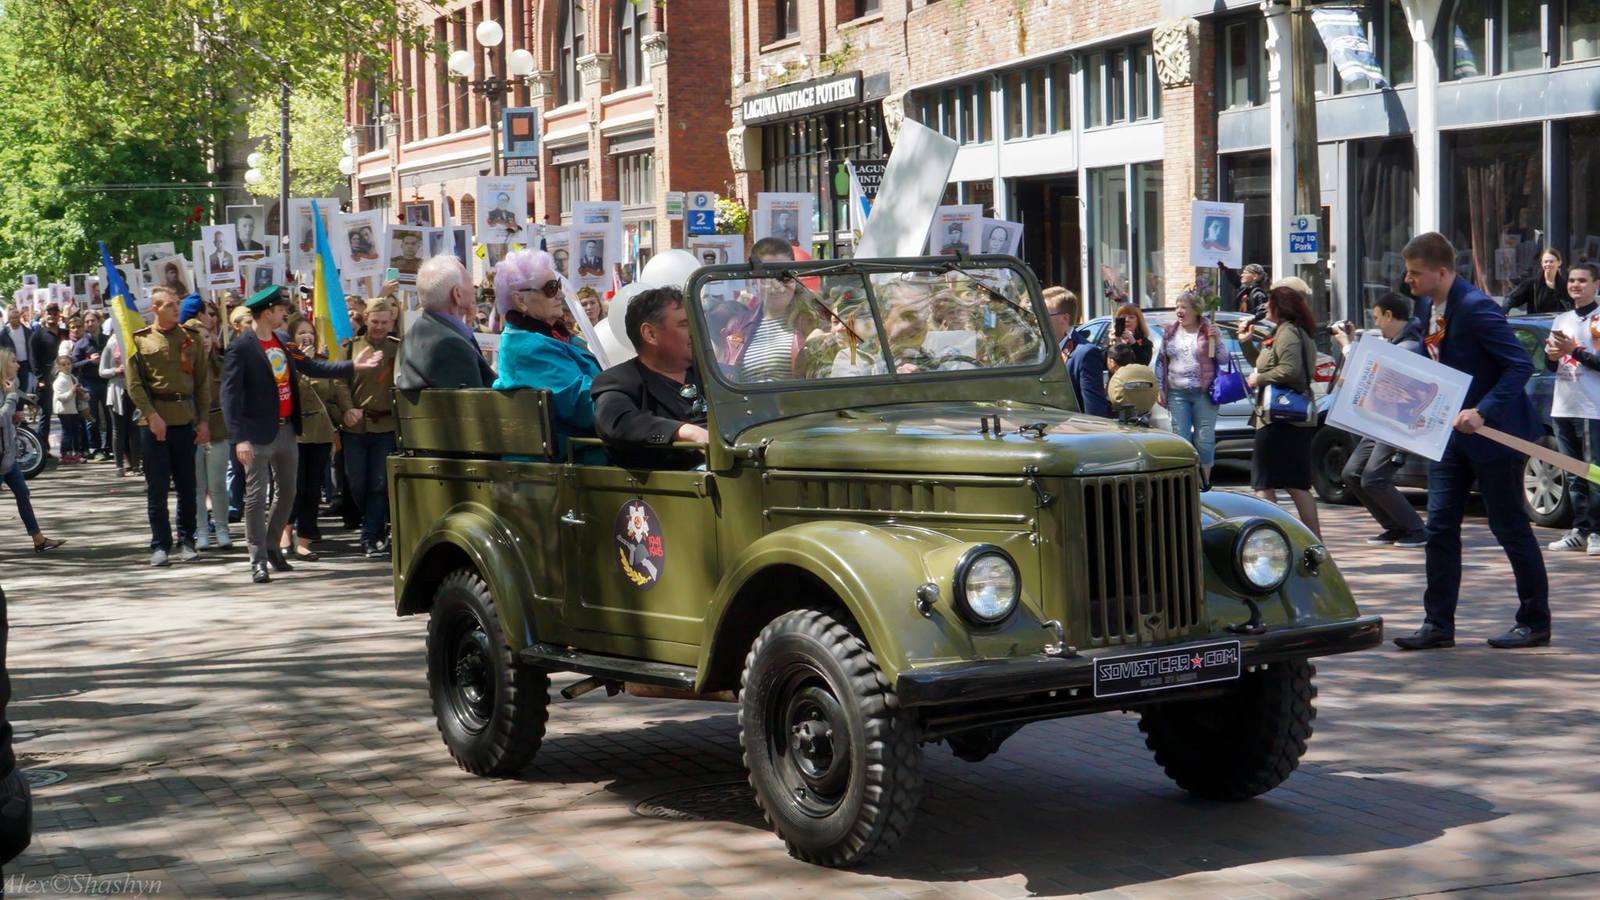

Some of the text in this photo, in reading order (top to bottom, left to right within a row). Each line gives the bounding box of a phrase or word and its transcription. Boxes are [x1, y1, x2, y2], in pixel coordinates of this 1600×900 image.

[743, 78, 856, 120] LAGUNA VINTAGE POTTERY
[855, 164, 887, 174] LAGUN
[696, 212, 706, 225] 2
[1291, 234, 1316, 243] Pay to
[1294, 243, 1312, 251] Park
